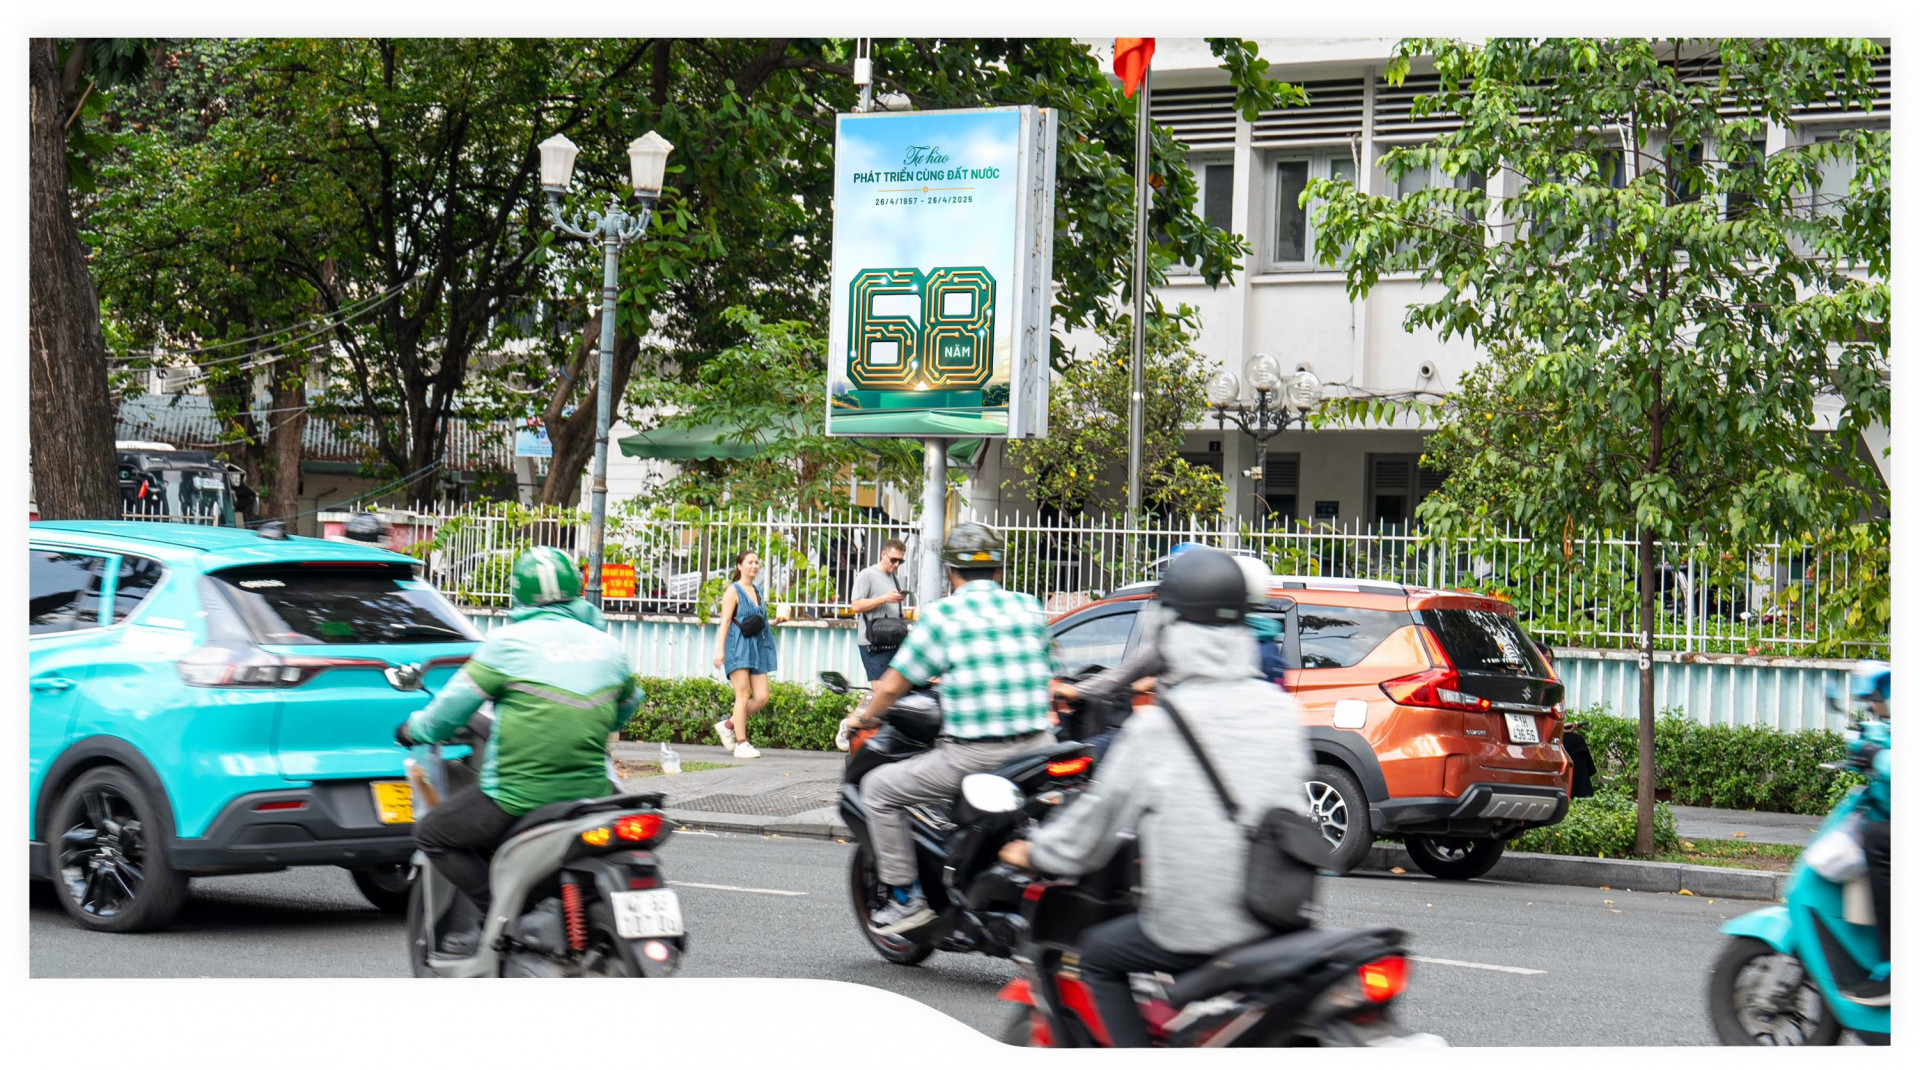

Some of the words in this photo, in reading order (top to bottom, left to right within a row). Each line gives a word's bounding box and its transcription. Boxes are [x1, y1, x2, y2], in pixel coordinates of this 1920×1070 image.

[903, 145, 930, 166] Tự
[925, 146, 949, 164] hào
[853, 169, 881, 183] PHÁT
[884, 166, 914, 182] TRIỂN
[916, 168, 944, 181] CÙNG
[947, 166, 969, 180] ĐẤT
[971, 166, 1000, 180] NƯỚC
[875, 197, 918, 206] 26/4/1957
[927, 196, 973, 205] 26/4/2025
[847, 266, 996, 390] 68
[944, 344, 970, 357] NĂM
